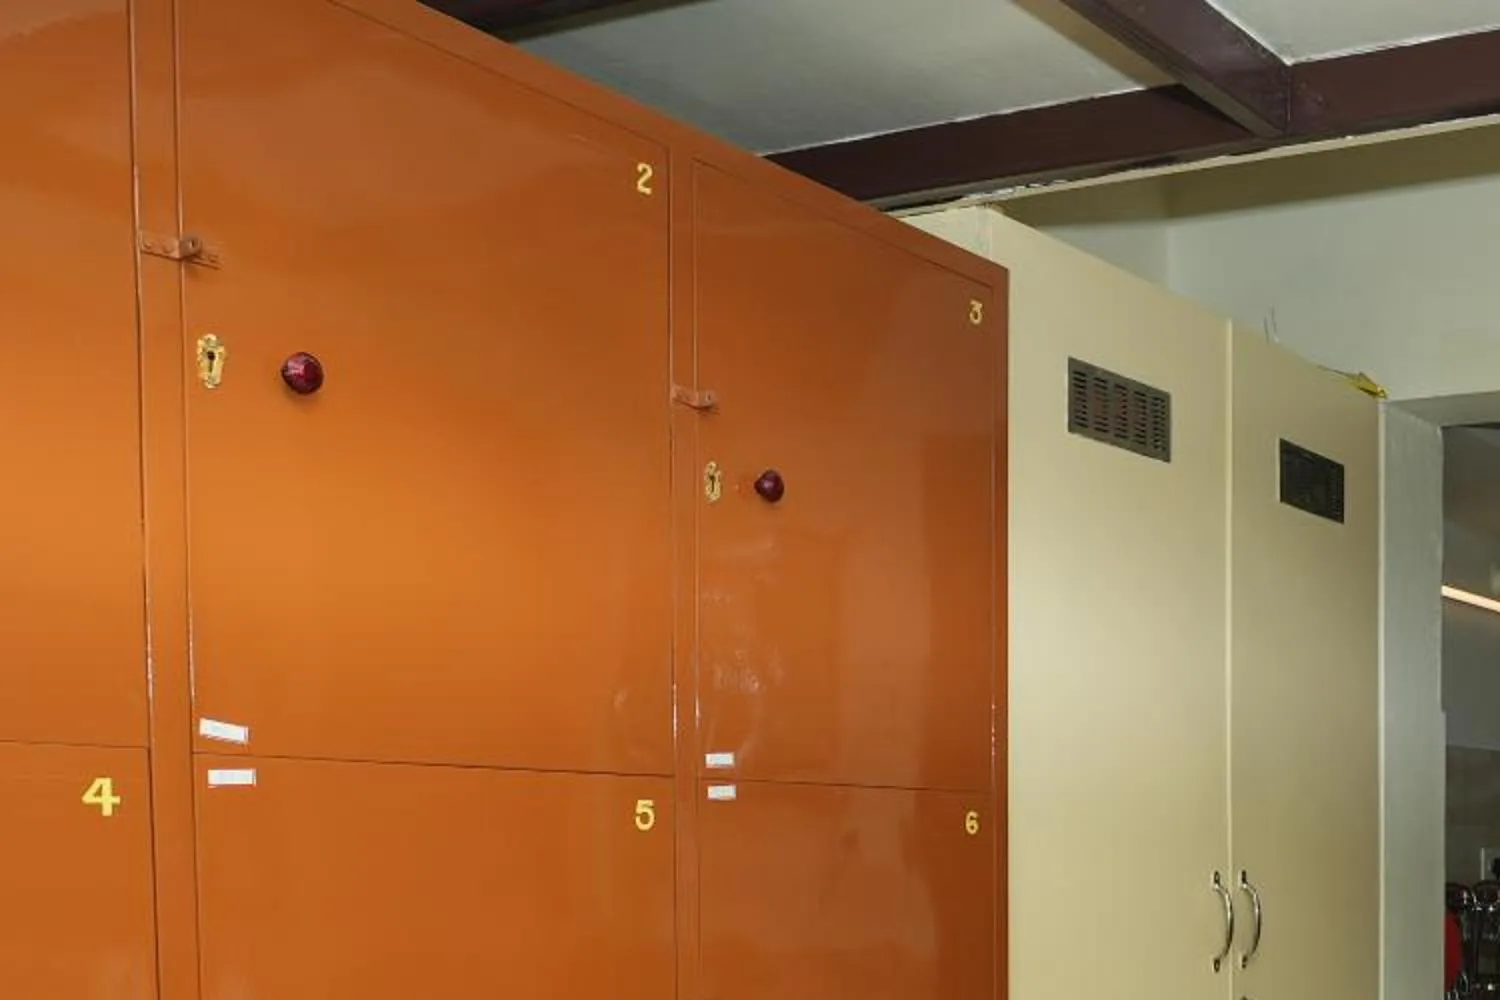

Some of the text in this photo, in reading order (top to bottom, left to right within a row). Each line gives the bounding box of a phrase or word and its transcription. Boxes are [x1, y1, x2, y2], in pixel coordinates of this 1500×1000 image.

[636, 162, 654, 196] 2
[81, 777, 121, 817] 4
[635, 799, 655, 831] 5
[965, 810, 979, 835] 6
